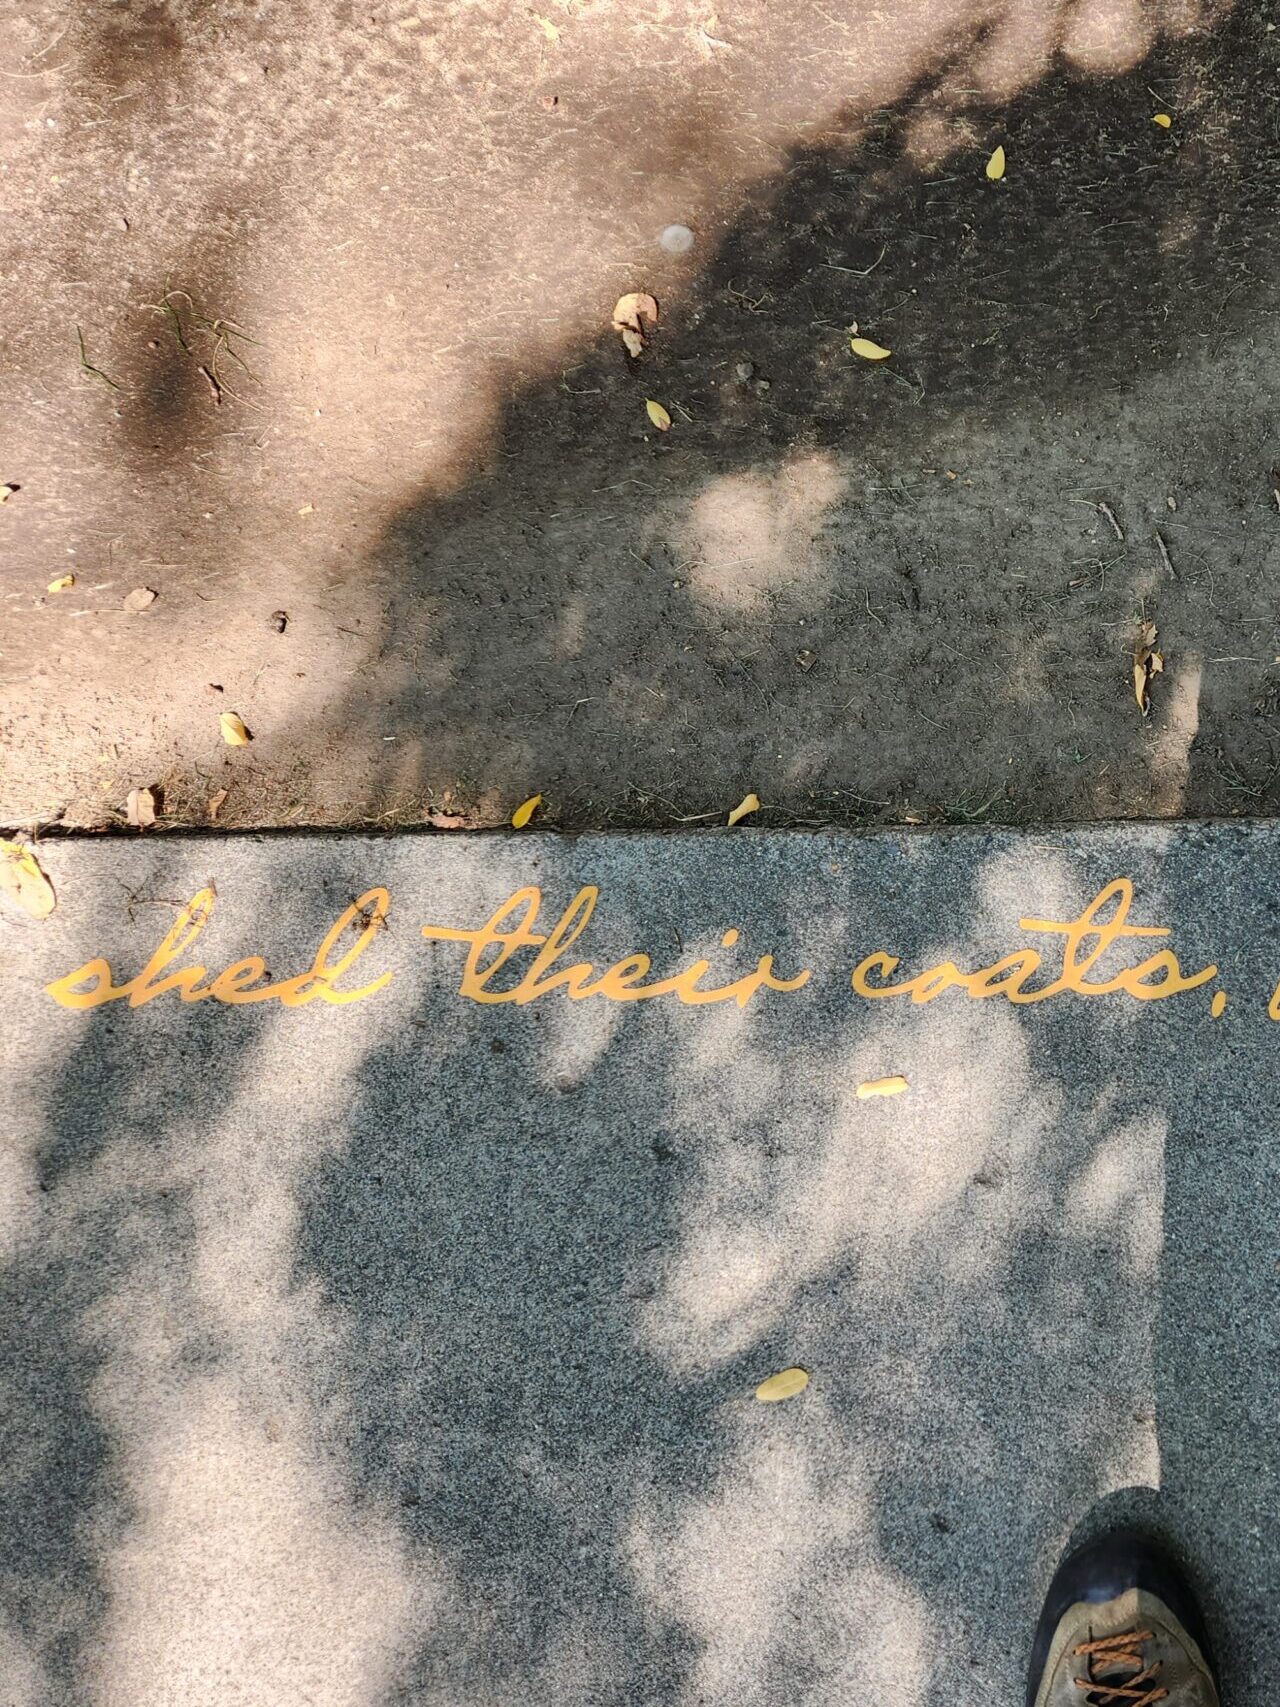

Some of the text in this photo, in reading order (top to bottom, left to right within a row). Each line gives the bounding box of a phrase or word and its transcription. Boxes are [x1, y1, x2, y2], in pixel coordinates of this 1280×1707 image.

[47, 886, 394, 1009] shed
[422, 886, 808, 1006] their
[851, 877, 1226, 1018] coats,
